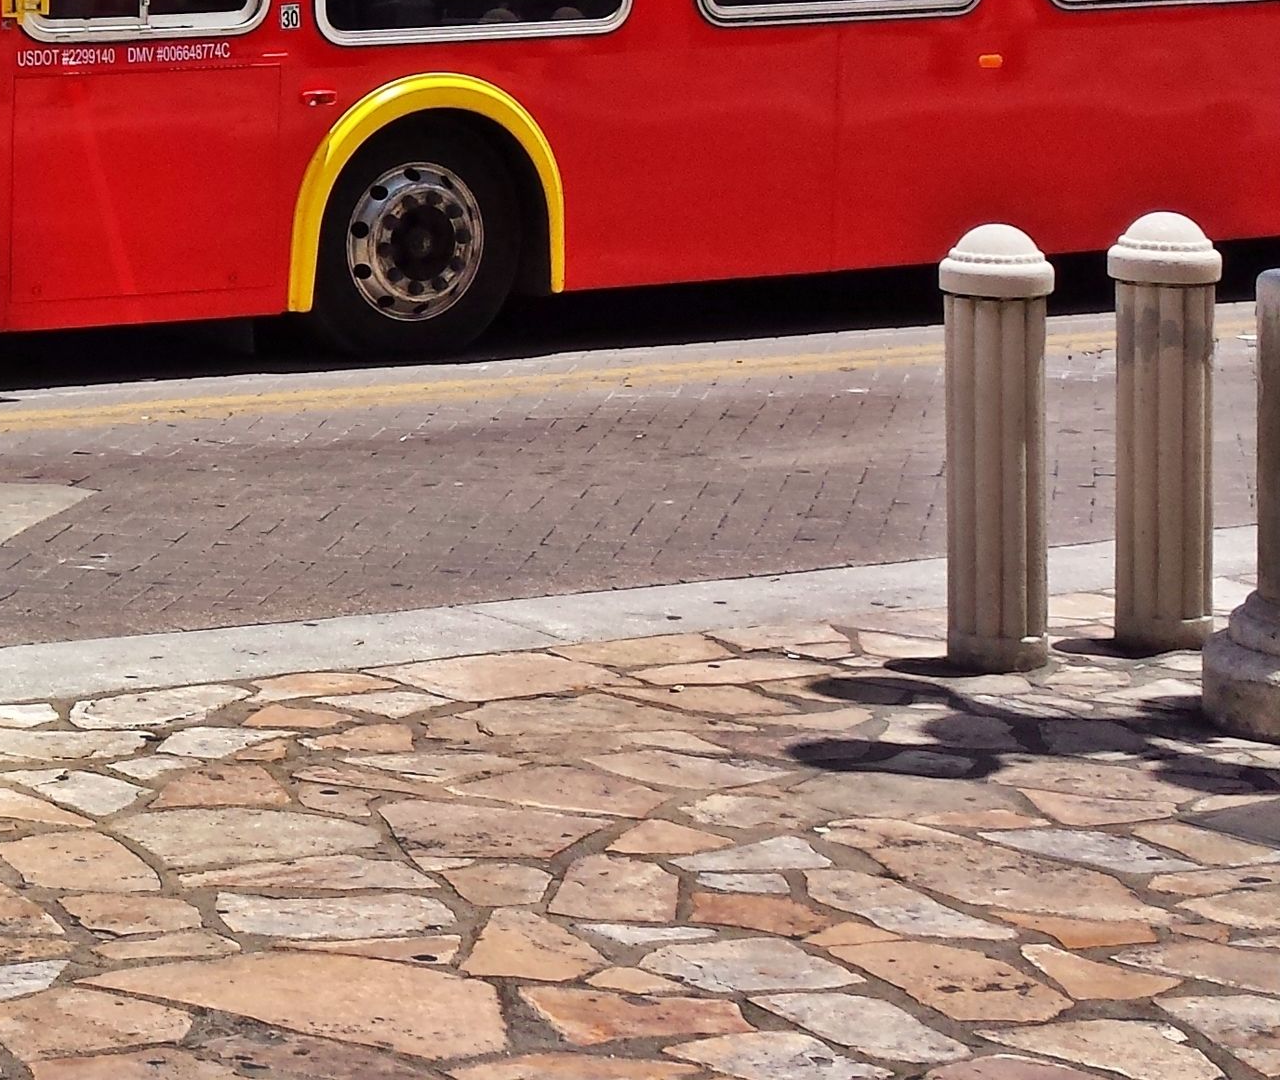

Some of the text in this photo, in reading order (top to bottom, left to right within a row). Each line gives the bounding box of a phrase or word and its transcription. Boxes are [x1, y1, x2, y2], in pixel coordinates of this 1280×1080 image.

[282, 9, 299, 28] 30
[16, 49, 60, 67] USDOT
[127, 46, 155, 63] DMV
